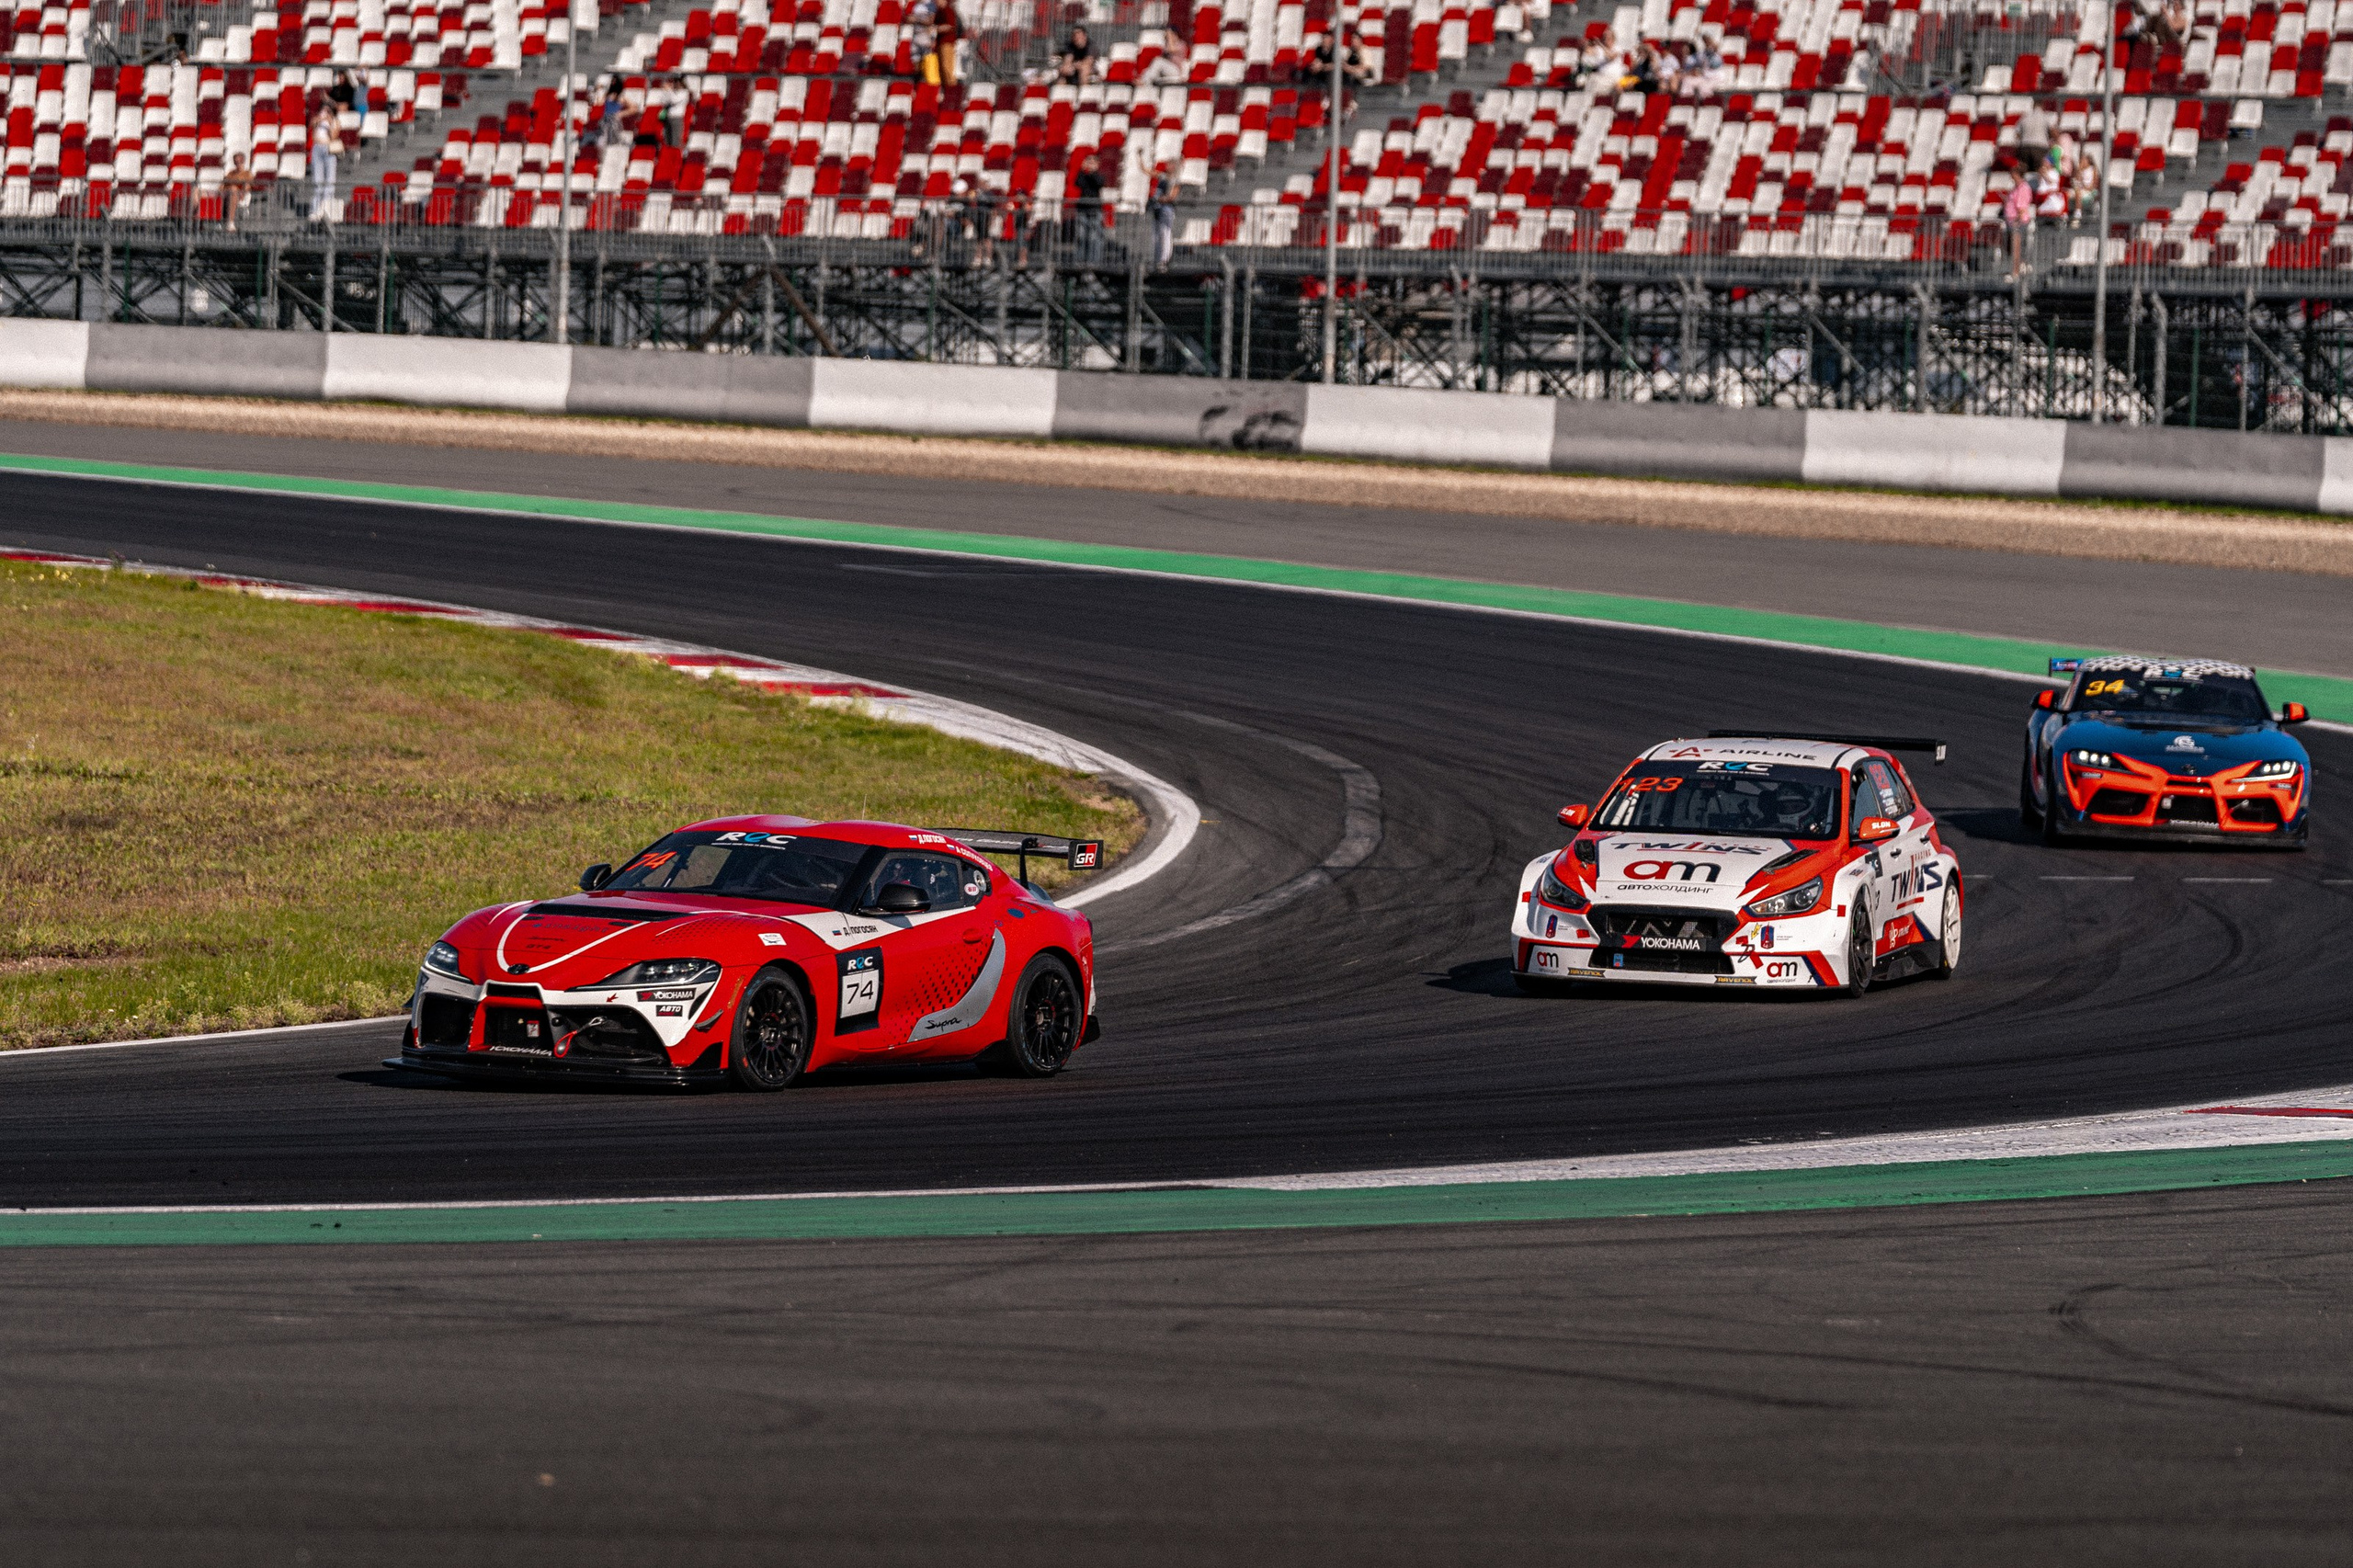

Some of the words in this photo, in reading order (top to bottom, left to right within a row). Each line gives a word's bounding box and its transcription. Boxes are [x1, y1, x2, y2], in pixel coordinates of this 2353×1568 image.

[2086, 679, 2124, 696] 34
[1719, 749, 1817, 760] AIRLINE
[1619, 777, 1683, 792] 123
[1610, 842, 1768, 855] TWINS
[625, 851, 677, 871] 74
[1076, 853, 1094, 864] GR
[1892, 855, 1943, 903] TWINS
[1617, 884, 1713, 894] автохолдинг
[1641, 937, 1700, 950] YOKOHAMA
[654, 991, 693, 999] YOKOHAMA
[847, 980, 874, 1005] 74
[924, 1017, 962, 1031] Supra
[489, 1045, 552, 1056] YOKOHAMA
